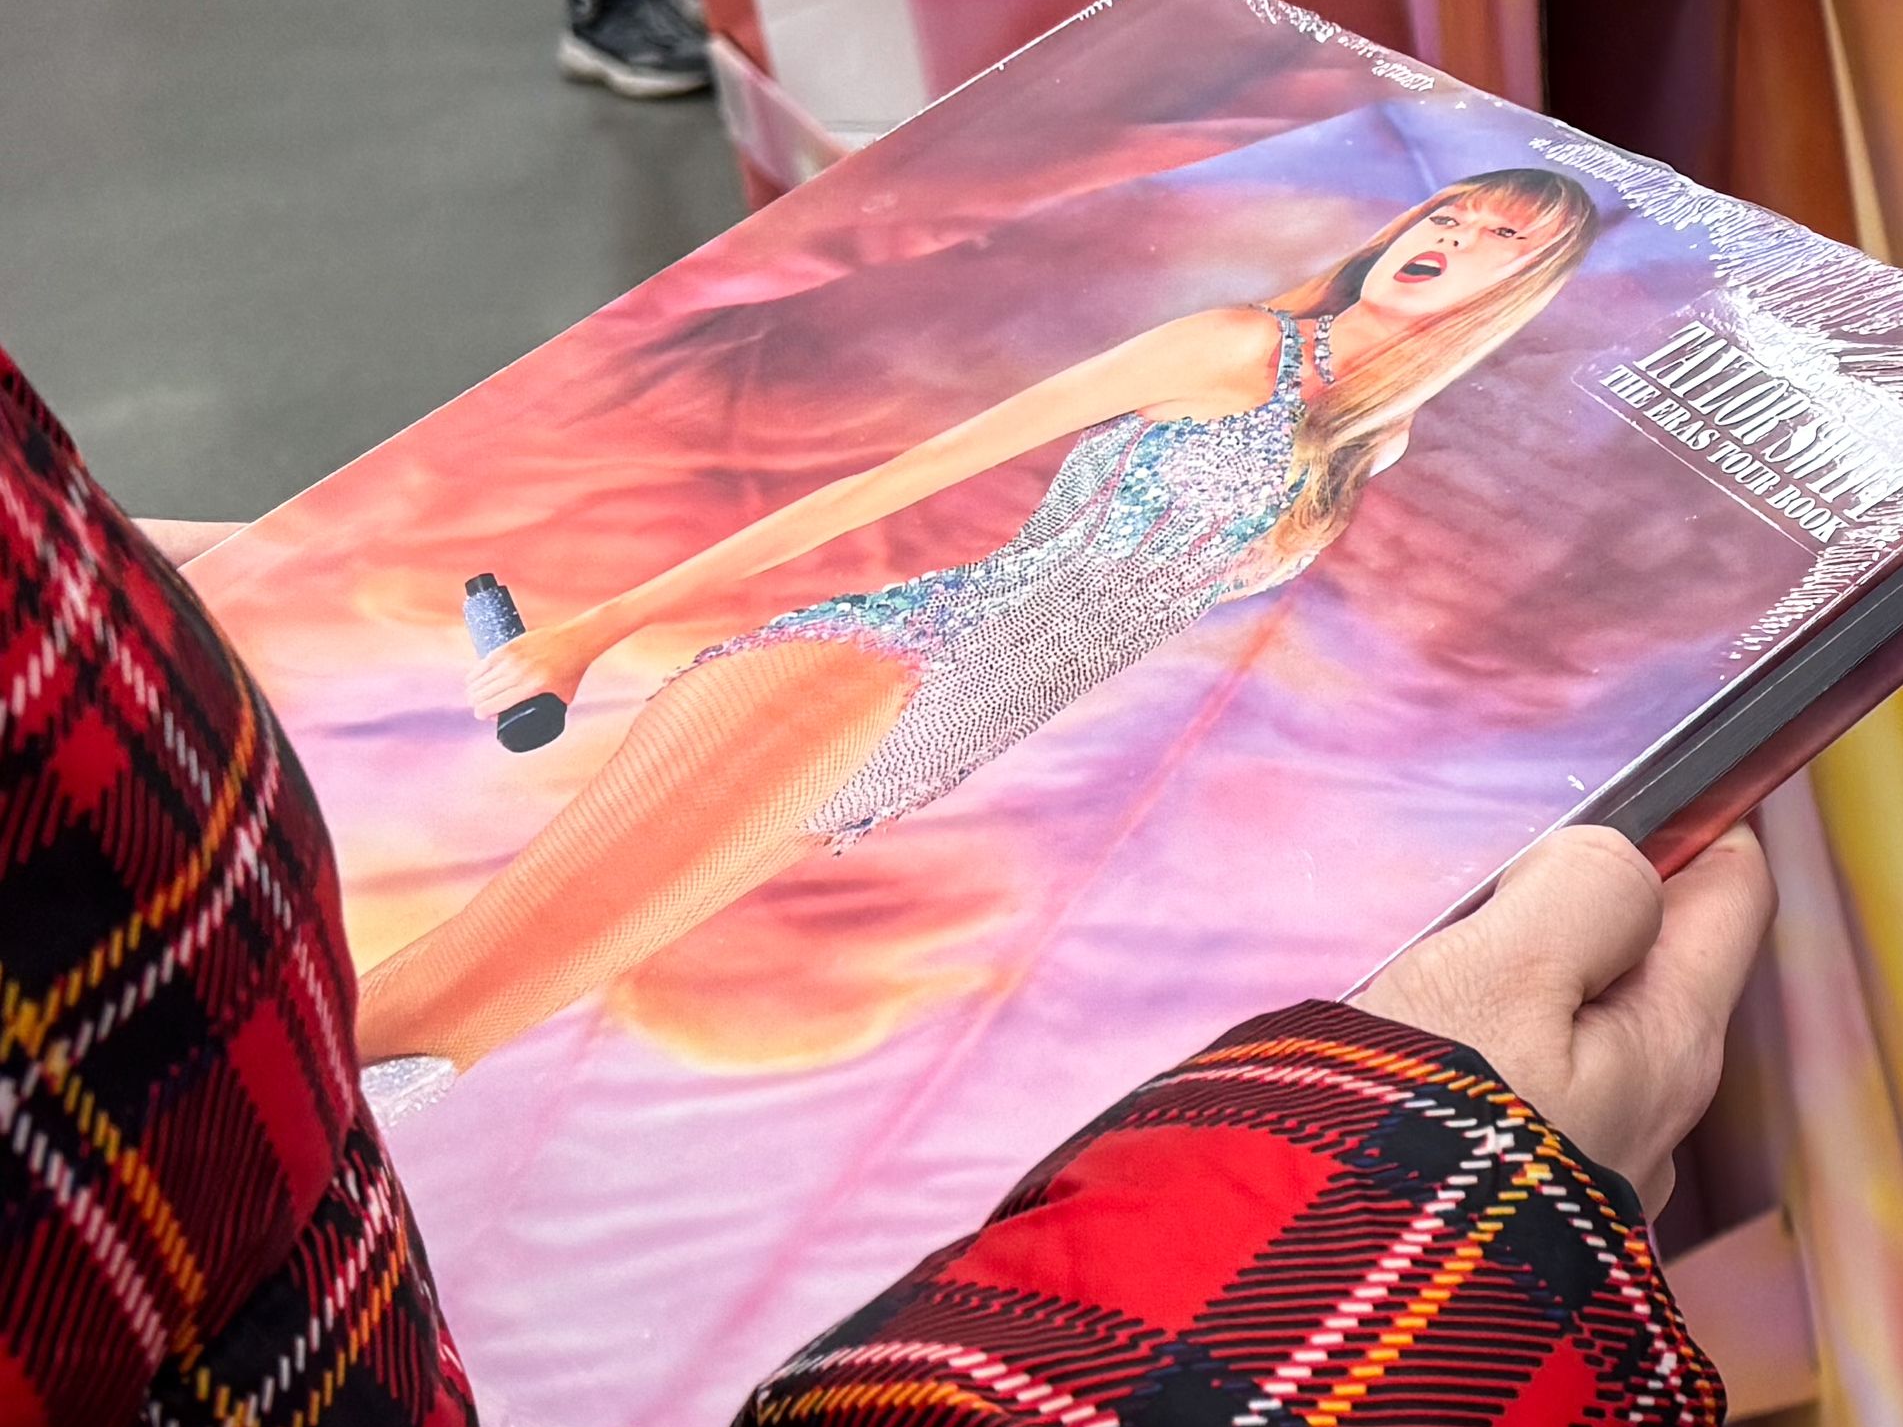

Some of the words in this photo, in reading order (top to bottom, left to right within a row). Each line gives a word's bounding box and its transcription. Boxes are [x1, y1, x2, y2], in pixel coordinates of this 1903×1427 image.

[1598, 363, 1662, 409] THE
[1642, 398, 1721, 451] ERAS
[1706, 440, 1782, 496] TOUR
[1765, 484, 1851, 544] BOOK
[1632, 319, 1812, 446] TAYLOR
